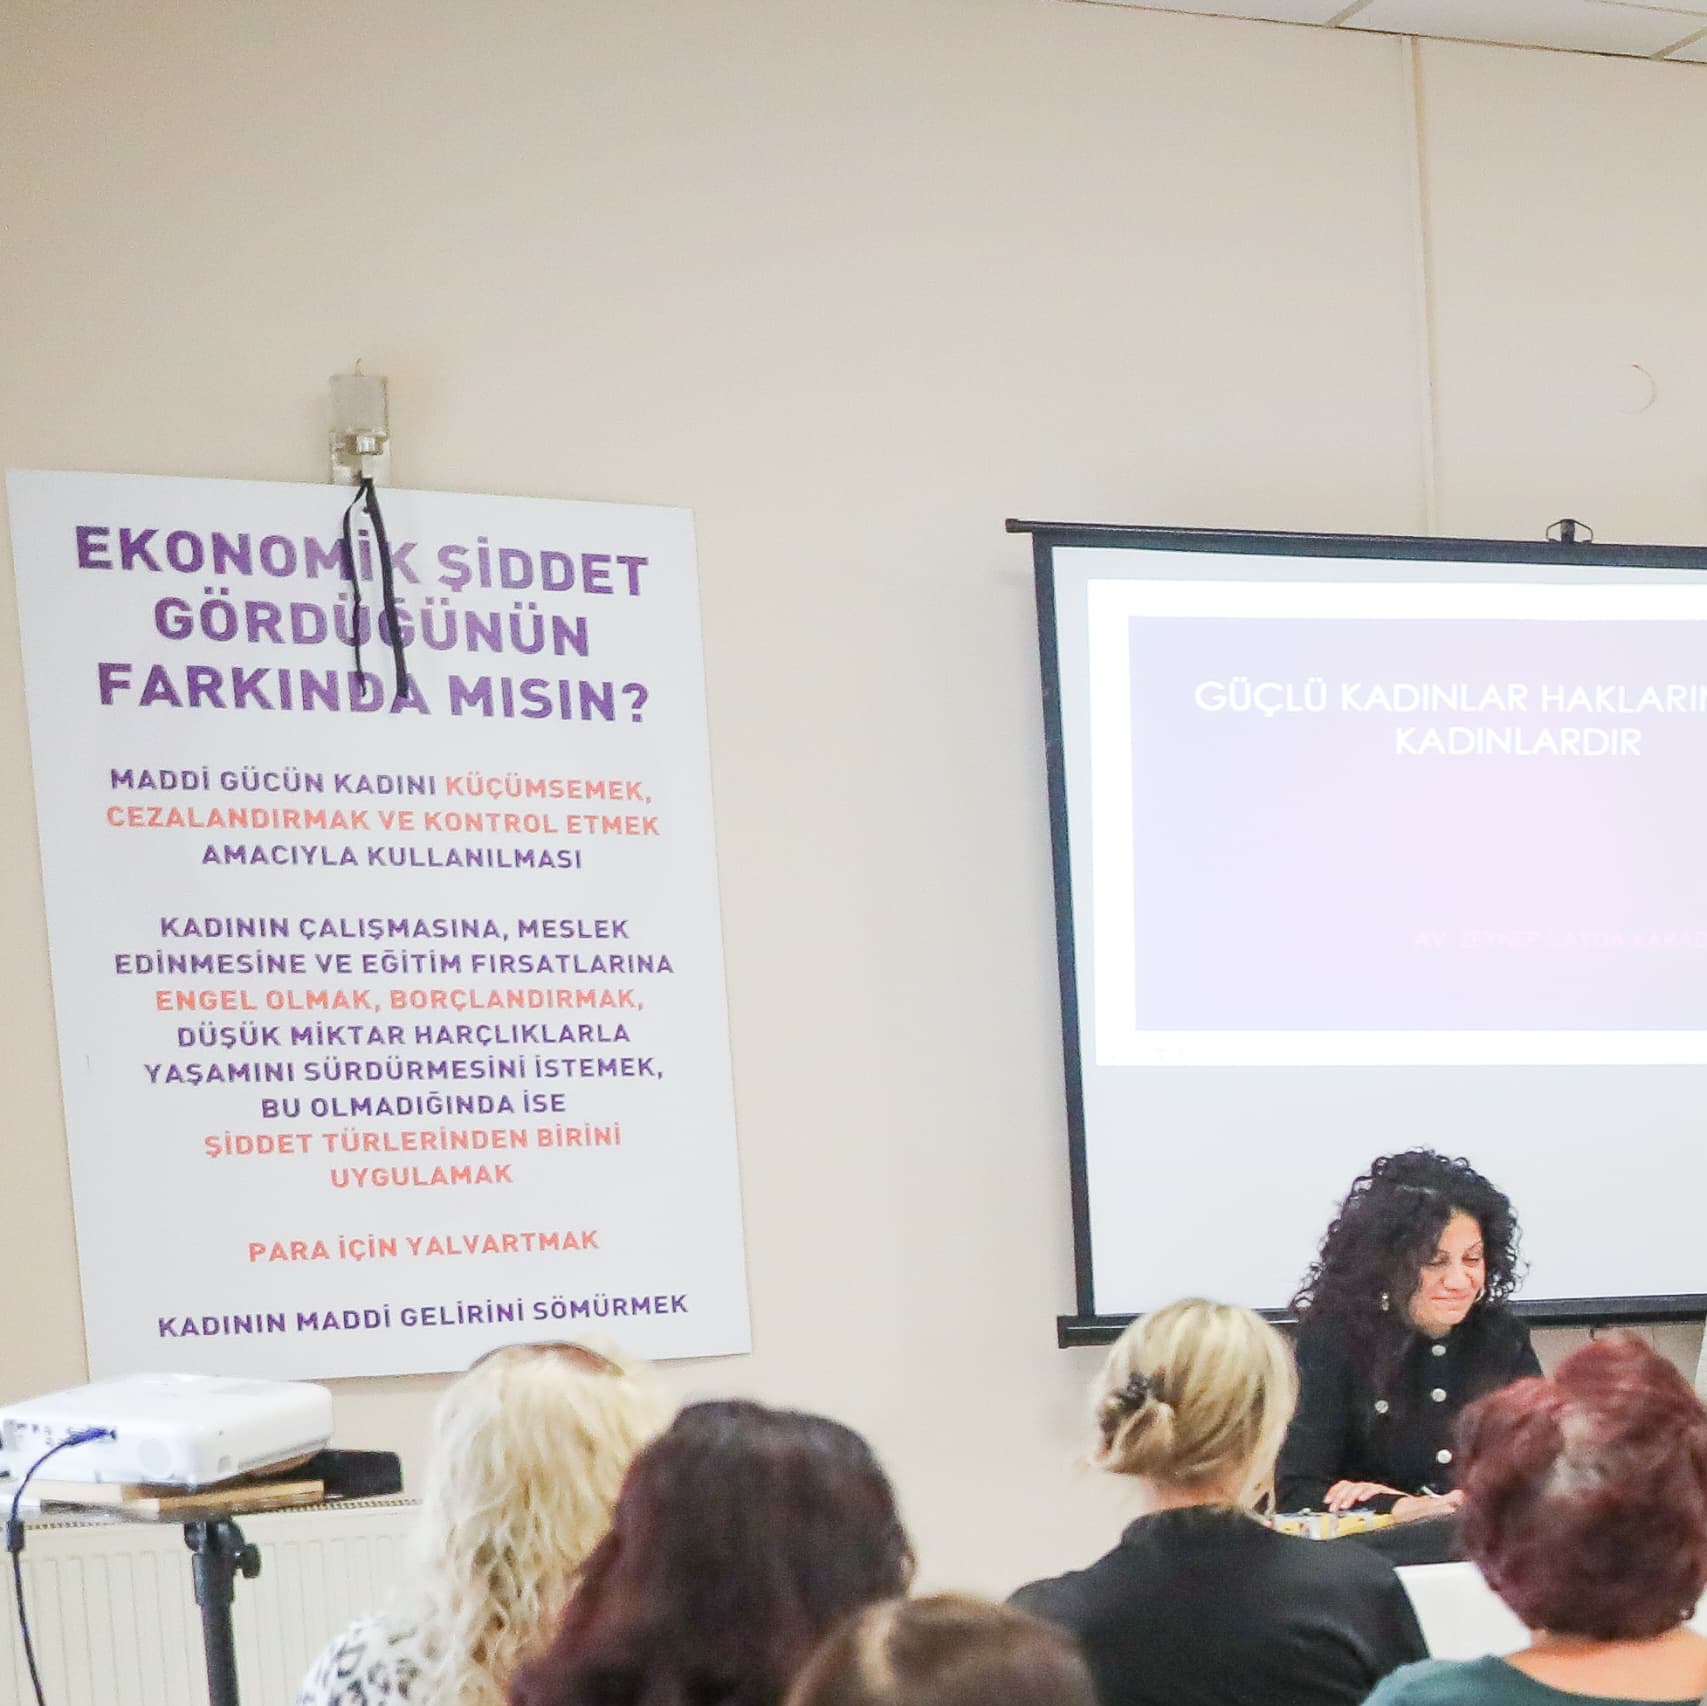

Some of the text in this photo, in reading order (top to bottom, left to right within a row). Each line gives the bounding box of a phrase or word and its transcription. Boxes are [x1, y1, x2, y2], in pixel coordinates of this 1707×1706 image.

[438, 536, 649, 596] ŞİDDET
[449, 675, 648, 722] MISIN?
[1195, 677, 1326, 717] GÜÇLÜ
[1342, 684, 1528, 712] KADINLAR
[1396, 727, 1640, 755] KADINLARDIR
[111, 766, 650, 803] MADDİ GÜCÜN KADINI KÜÇÜMSEMEK,
[107, 805, 659, 835] CEZALANDIRMAK VE KONTROL ETMEK
[202, 845, 581, 868] AMACIYLA KULLANILMASI
[161, 917, 628, 941] KADININ ÇALIŞMASINA, MESLEK
[115, 949, 673, 974] EDİNMESİNE VE EĞİTİM FIRSATLARINA
[156, 989, 643, 1013] ENGEL OLMAK, BORÇLANDIRMAK,
[178, 1021, 629, 1049] DÜŞÜK MİKTAR HARÇLIKLARLA
[144, 1055, 662, 1086] YAŞAMINI SÜRDÜRMESİNİ İSTEMEK,
[262, 1090, 565, 1118] BU OLMADIĞINDA İSE
[205, 1122, 620, 1158] ŞİDDET TÜRLERİNDEN BİRİNİ
[331, 1165, 512, 1188] UYGULAMAK
[249, 1230, 598, 1262] PARA İÇİN YALVARTMAK
[159, 1294, 687, 1337] KADININ MADDİ GELİRİNİ SÖMÜRMEK
